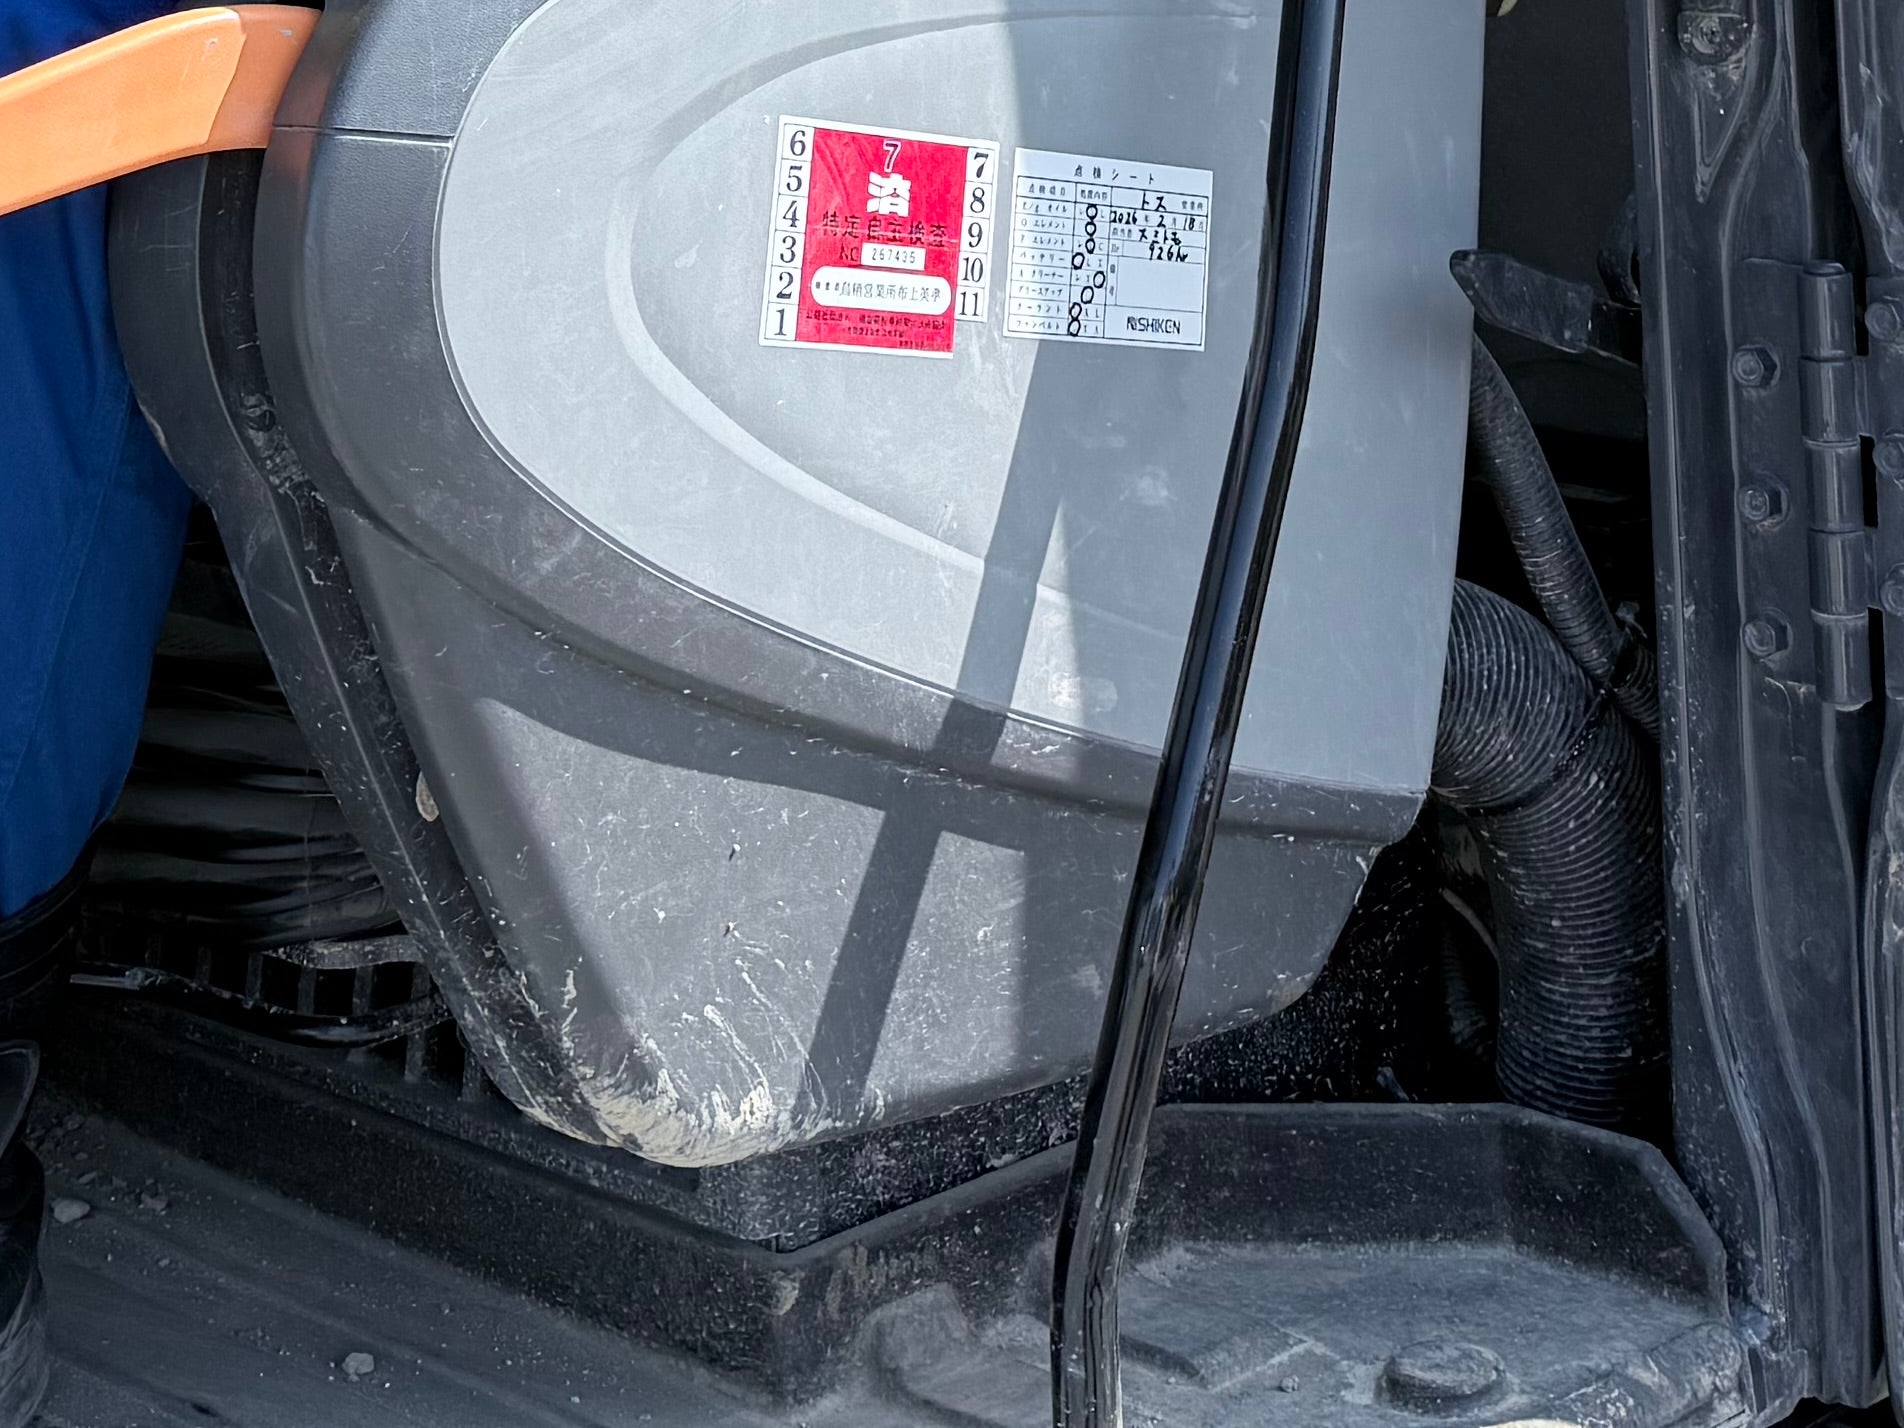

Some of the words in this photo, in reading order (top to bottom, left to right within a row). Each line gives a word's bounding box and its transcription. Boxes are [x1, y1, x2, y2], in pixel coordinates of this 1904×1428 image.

[790, 130, 806, 157] 6
[882, 139, 902, 173] 7
[786, 165, 803, 192] 5
[973, 152, 989, 179] 7
[866, 171, 912, 217] 済
[969, 187, 985, 214] 8
[782, 200, 800, 228] 4
[1156, 214, 1166, 228] 2
[822, 210, 947, 248] 特定自主検査
[968, 221, 983, 249] 9
[780, 235, 797, 264] 3
[872, 248, 916, 264] 267435
[962, 256, 984, 283] 10
[776, 271, 794, 300] 2
[959, 290, 980, 317] 11
[773, 308, 787, 337] 1
